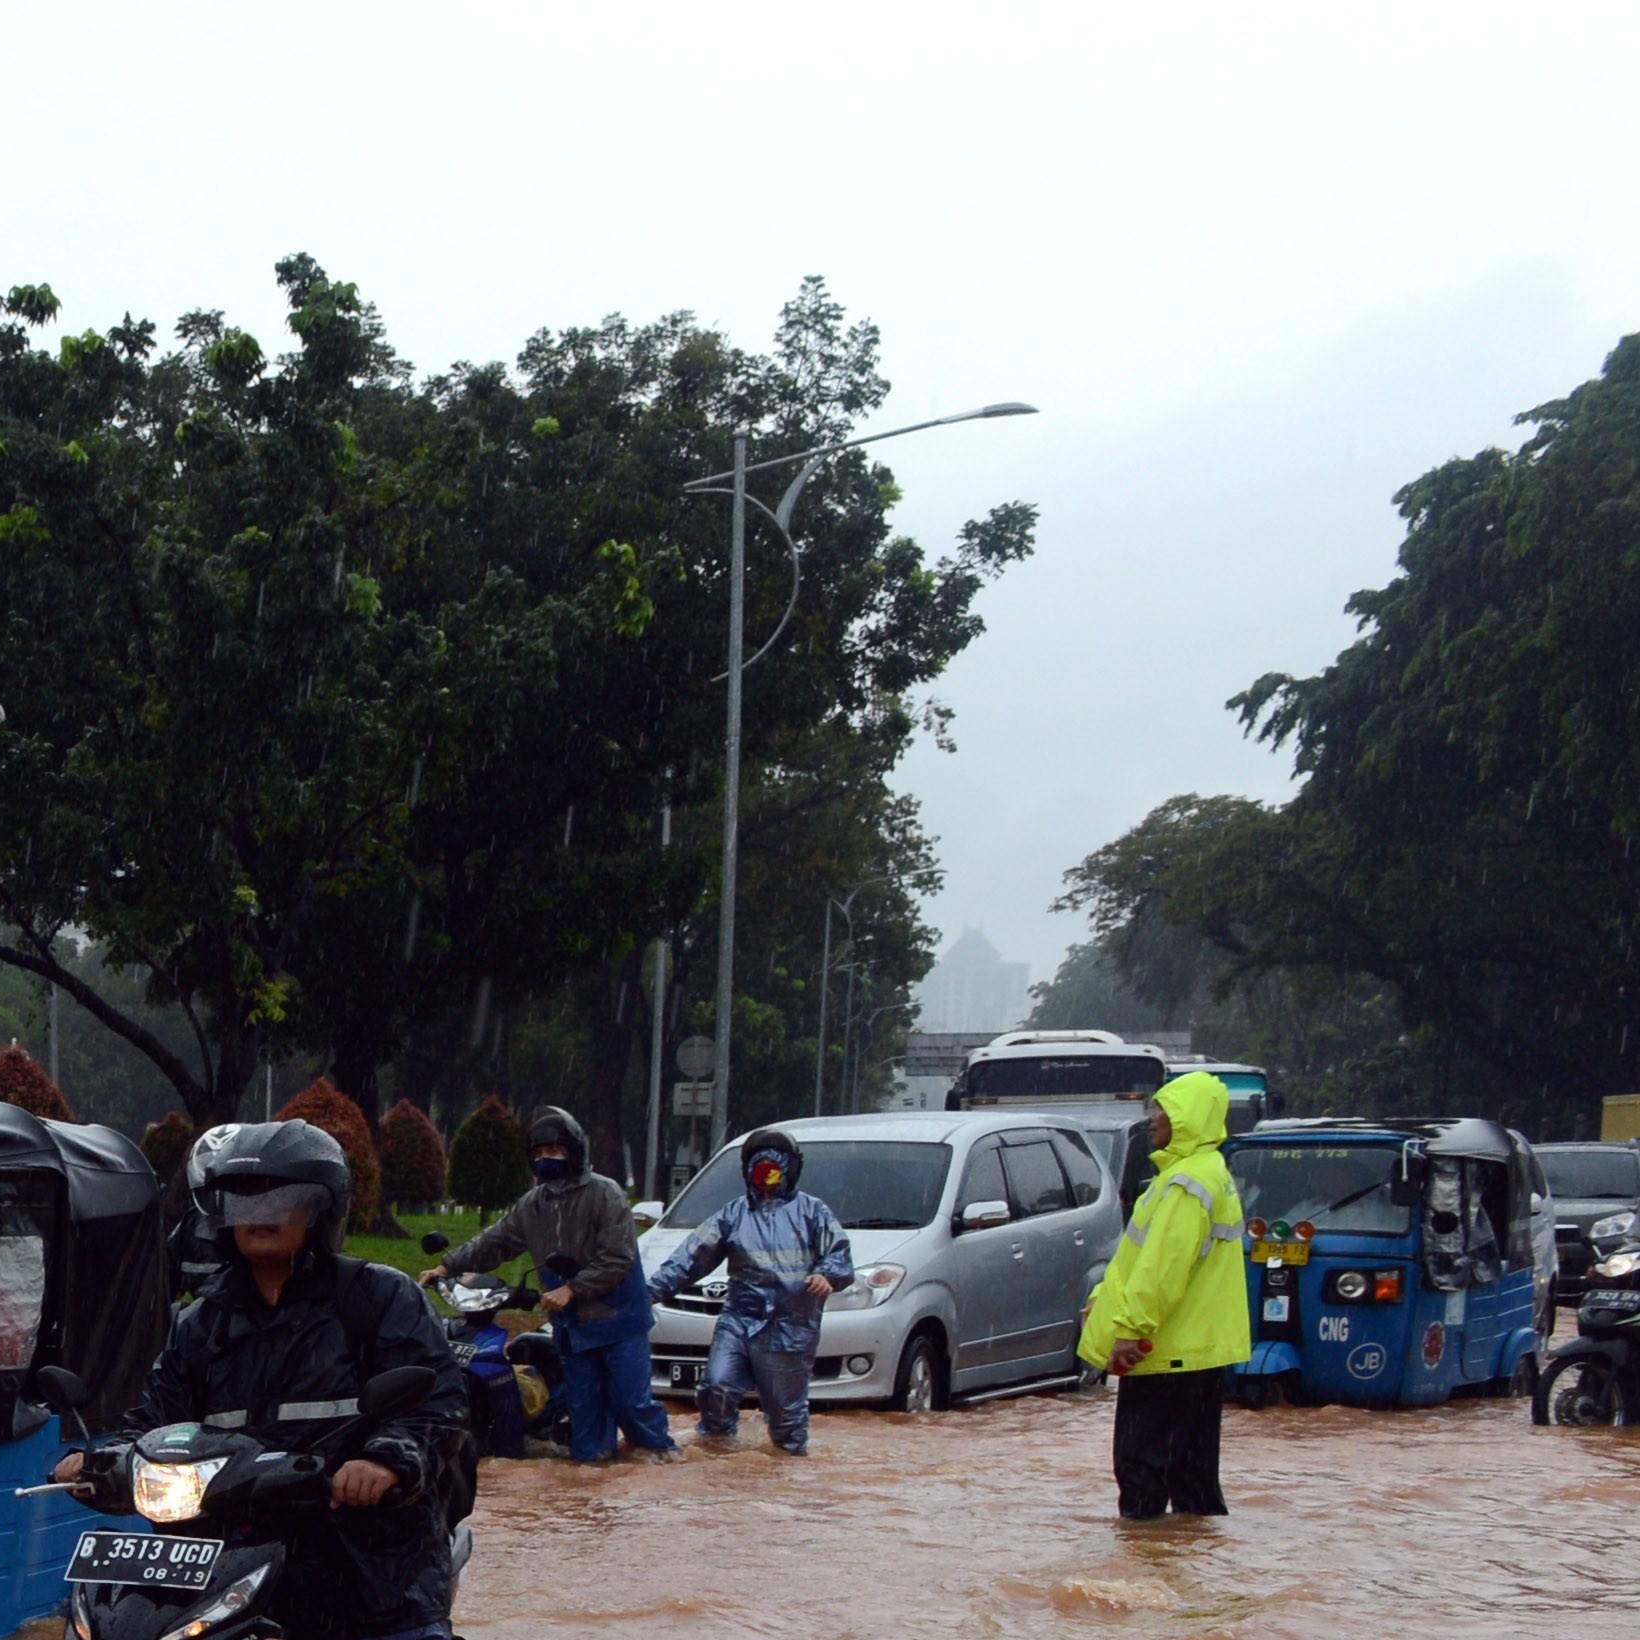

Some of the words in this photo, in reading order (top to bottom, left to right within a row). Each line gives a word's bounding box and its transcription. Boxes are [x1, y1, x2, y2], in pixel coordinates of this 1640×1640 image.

[1319, 1316, 1350, 1343] CNG
[672, 1365, 681, 1381] B
[1354, 1352, 1381, 1371] JB
[79, 1536, 97, 1558] B
[108, 1537, 165, 1561] 3513
[169, 1542, 215, 1565] UGD
